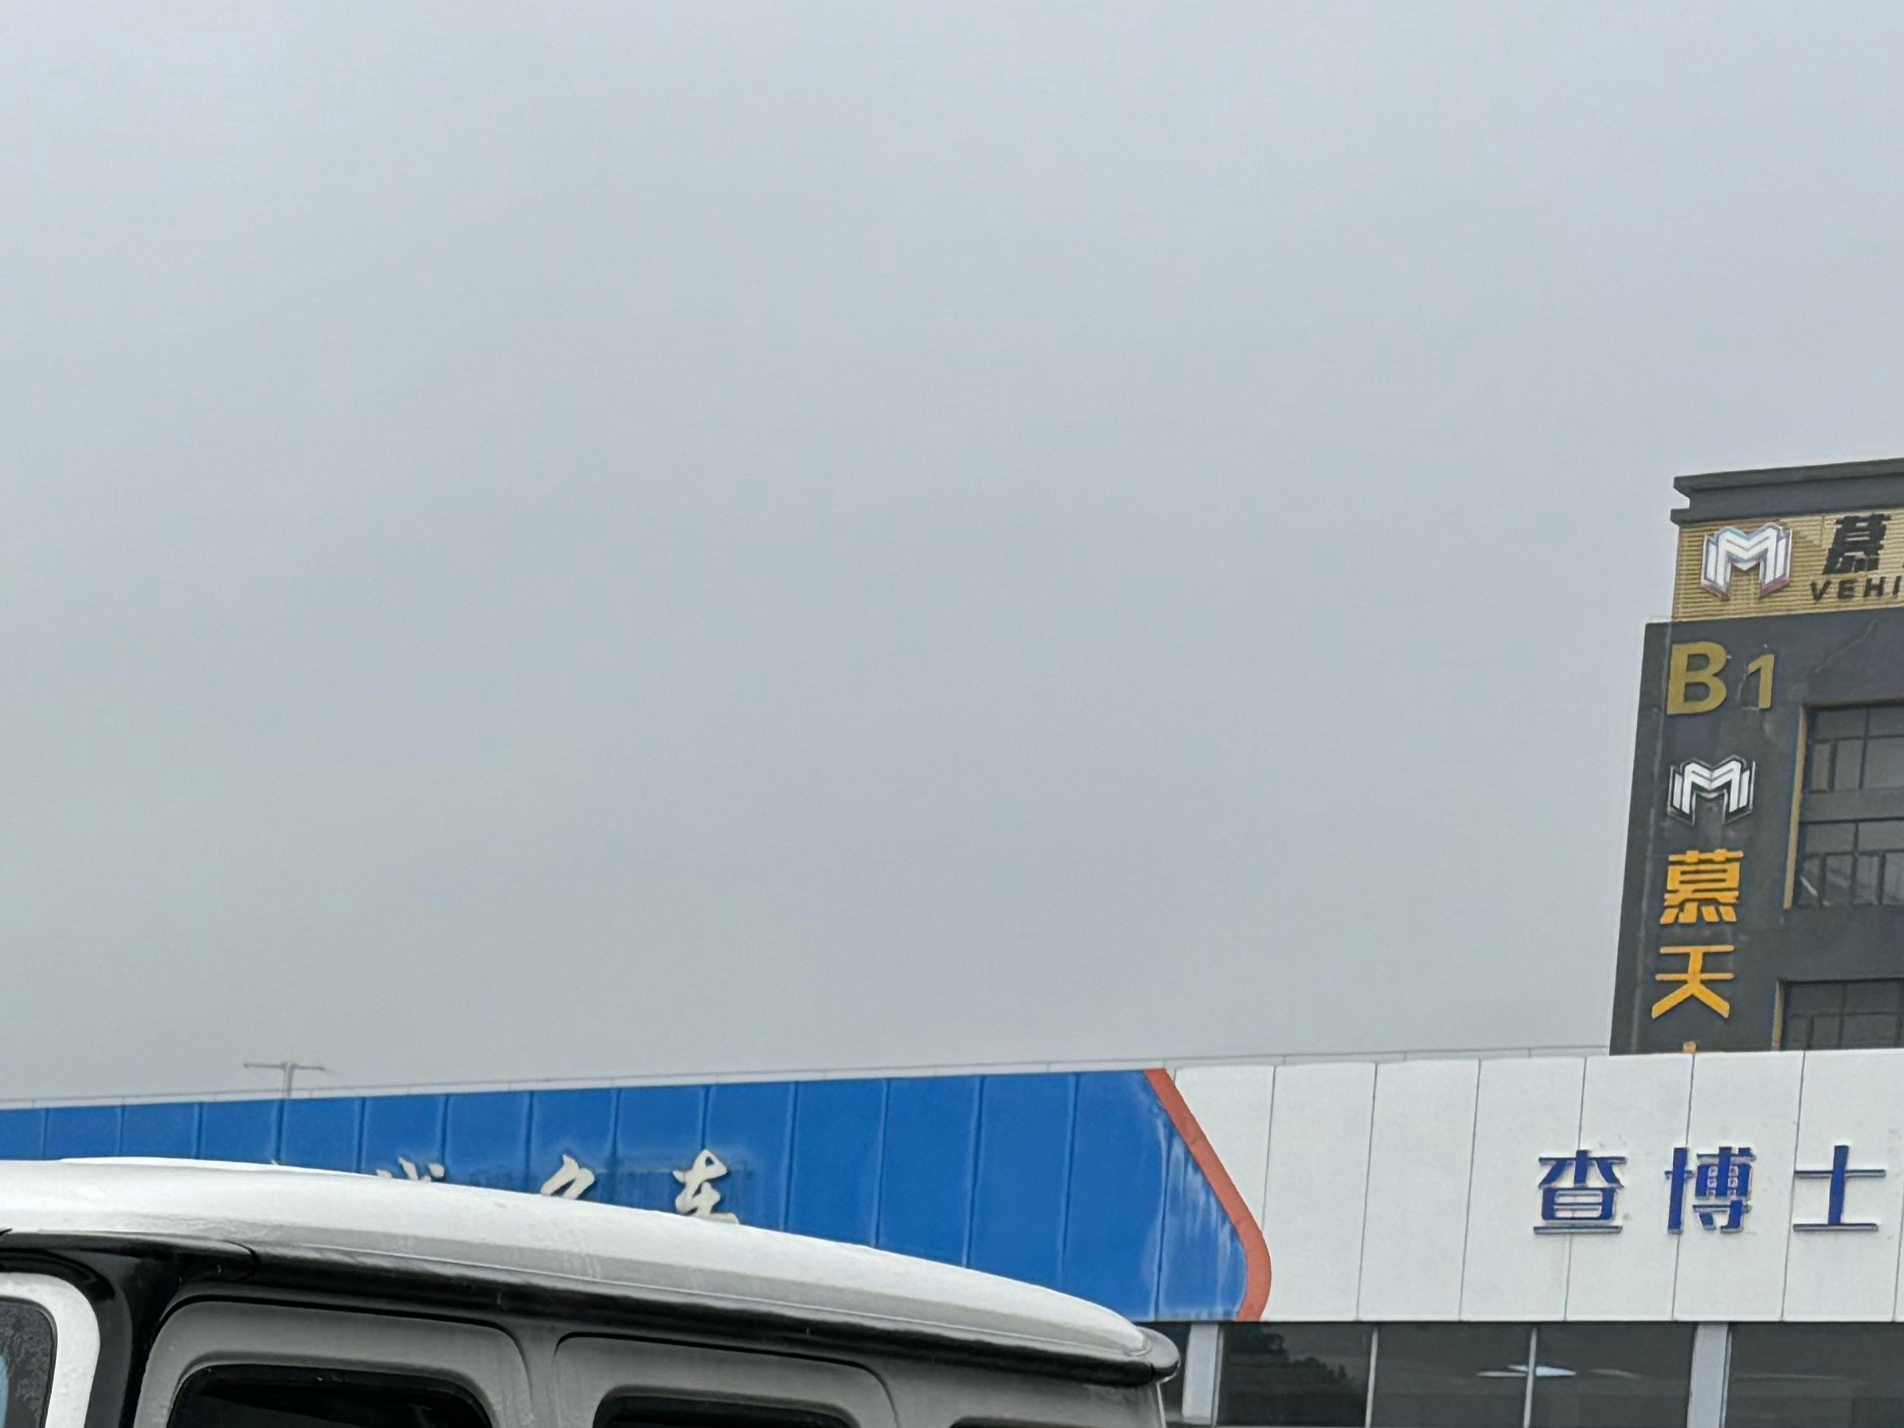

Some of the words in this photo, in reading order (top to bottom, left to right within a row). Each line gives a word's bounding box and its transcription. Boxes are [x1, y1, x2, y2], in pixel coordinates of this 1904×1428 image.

[1666, 641, 1775, 716] B1
[1651, 850, 1744, 1053] 慕天
[1533, 1145, 1887, 1235] 查博士
